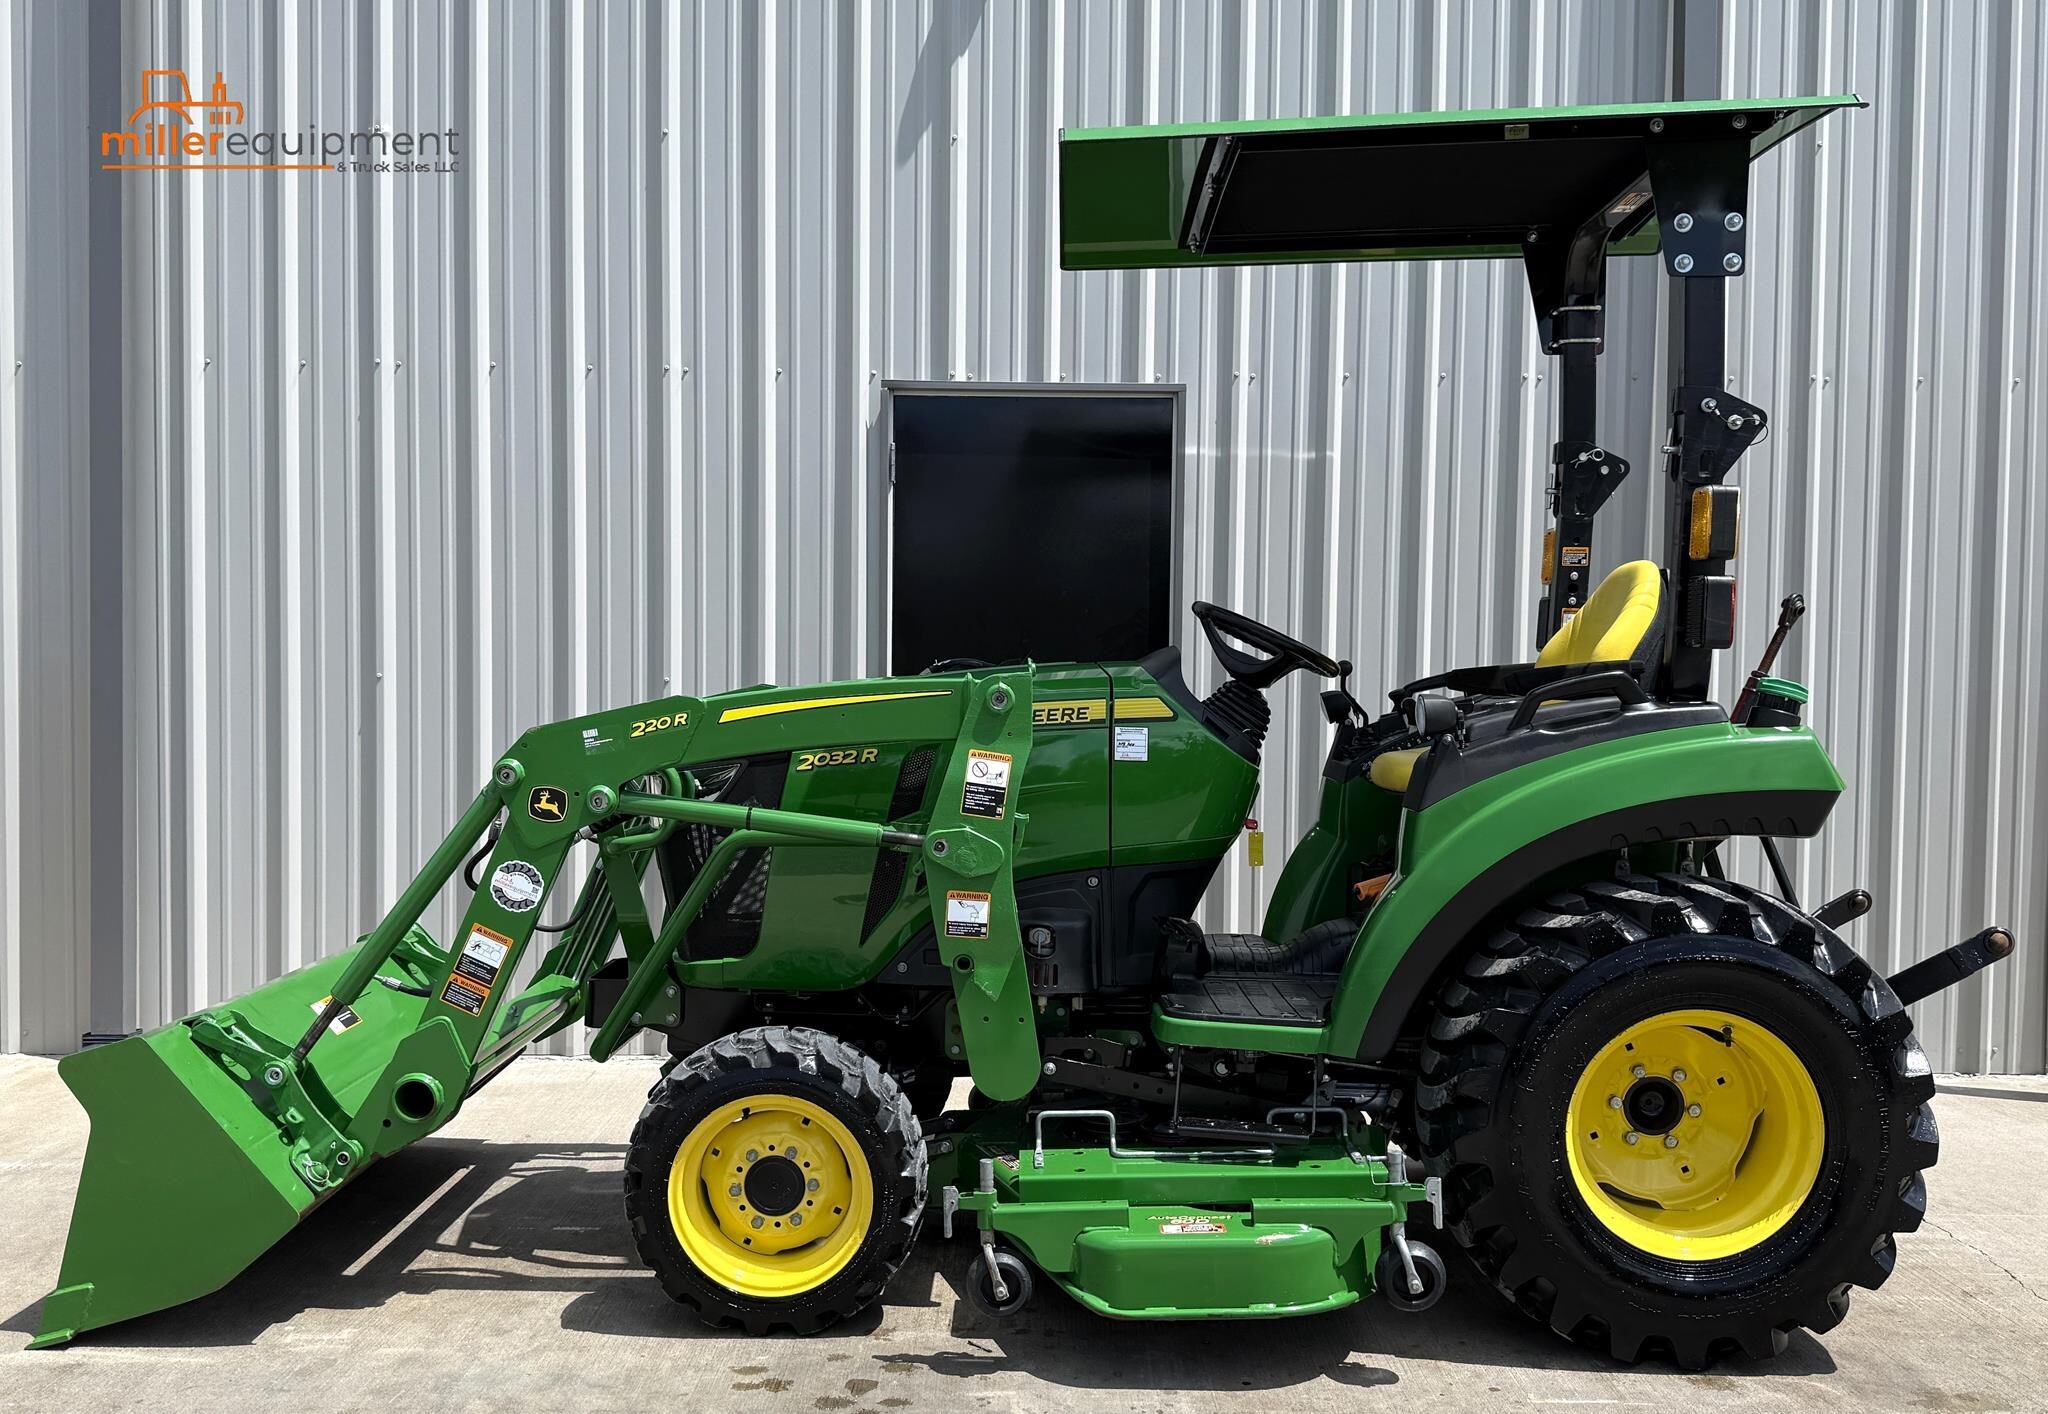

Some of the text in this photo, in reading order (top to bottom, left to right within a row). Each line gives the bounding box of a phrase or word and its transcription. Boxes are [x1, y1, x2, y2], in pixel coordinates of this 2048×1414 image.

[1032, 707, 1090, 722] EERE
[977, 751, 1010, 762] WARNING
[956, 892, 989, 900] WARNING
[482, 928, 509, 945] WARNING
[460, 980, 485, 995] WARNING
